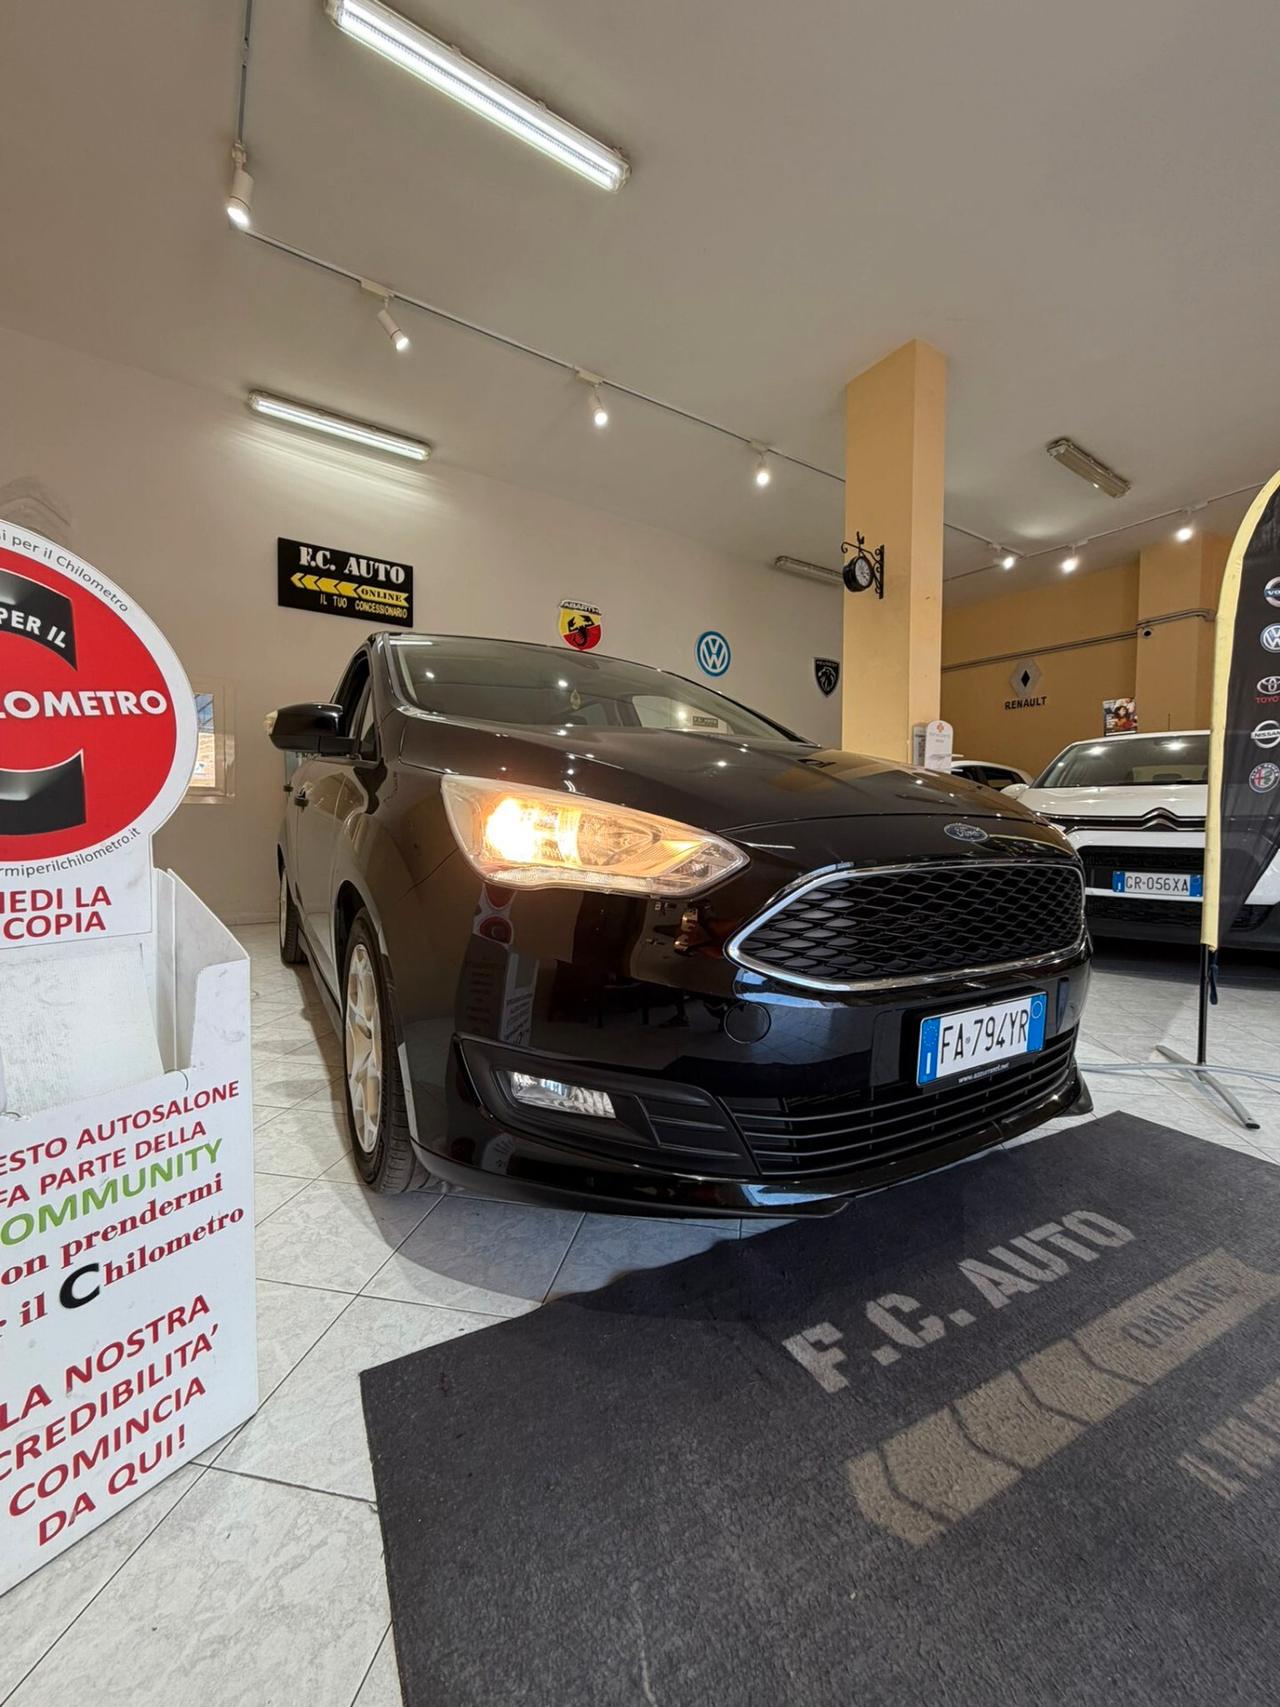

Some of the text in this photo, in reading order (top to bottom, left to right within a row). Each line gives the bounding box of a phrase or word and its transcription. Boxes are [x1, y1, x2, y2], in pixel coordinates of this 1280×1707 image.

[12, 535, 40, 553] per
[43, 547, 53, 560] il
[56, 555, 129, 612] Chilometro
[299, 546, 405, 584] F.C. AUTO
[361, 588, 403, 603] ONLINE
[46, 626, 67, 649] IL
[320, 594, 408, 619] IL TUO CONCESSIONARIO
[0, 690, 167, 719] OMETRO
[1004, 696, 1048, 710] RENAULT
[1256, 695, 1280, 704] TOYO
[3, 911, 106, 940] COPIA
[75, 885, 112, 908] LA
[76, 1080, 239, 1150] AUTOSALONE
[0, 1138, 223, 1246] OMMUNITY
[41, 1148, 127, 1195] PARTE
[135, 1121, 207, 1160] DELLA
[1, 1173, 224, 1286] on prendermi
[958, 1210, 1135, 1309] AUTO
[20, 1208, 244, 1327] il Chilometro
[65, 1295, 210, 1394] NOSTRA
[9, 1376, 206, 1517] COMINCIA
[38, 1424, 186, 1547] DA QUI!
